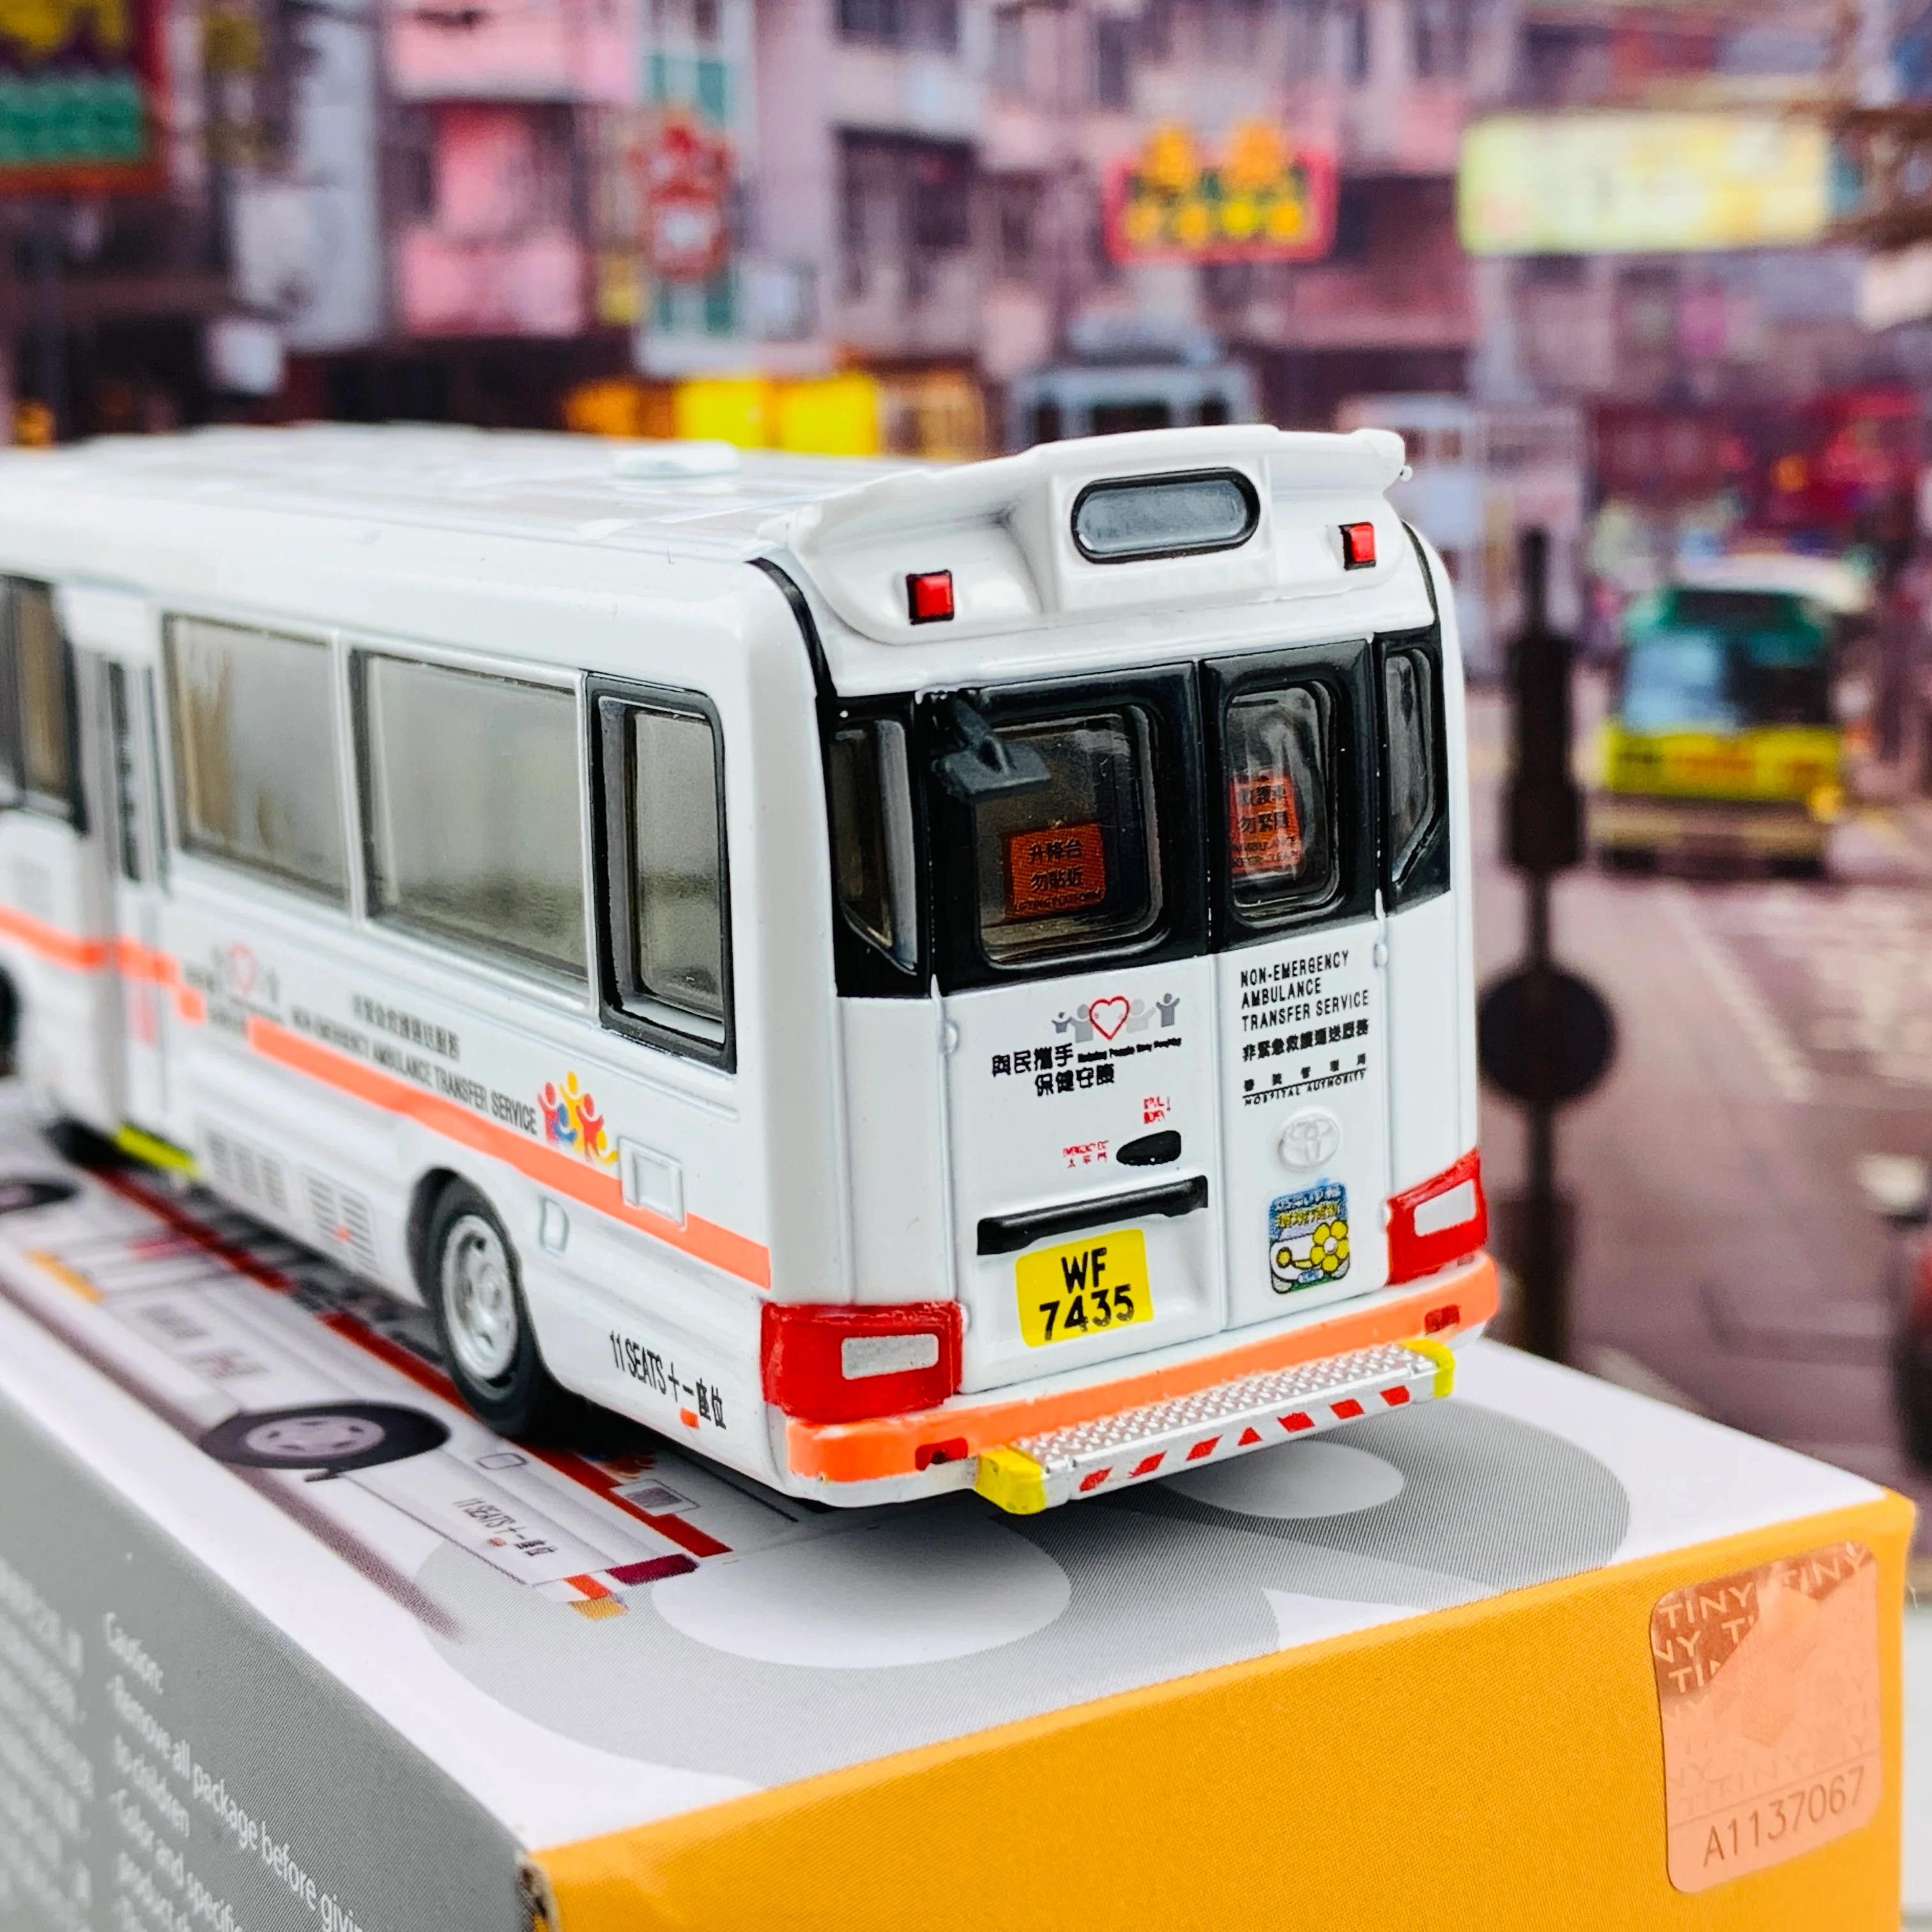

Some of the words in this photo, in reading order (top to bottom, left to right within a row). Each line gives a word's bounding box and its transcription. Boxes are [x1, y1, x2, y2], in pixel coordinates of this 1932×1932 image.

[1241, 949, 1349, 988] NON-EMERGENCY
[1241, 977, 1321, 1009] AMBULANCE
[1242, 1003, 1310, 1031] TRANSFER
[1315, 989, 1368, 1016] SERVICE
[434, 1064, 489, 1113] TRANSFER
[491, 1089, 538, 1136] SERVICE
[1061, 1247, 1107, 1294] WF
[1039, 1284, 1134, 1342] 7435
[610, 1330, 625, 1372] 11
[625, 1338, 666, 1395] SEATS
[1658, 1582, 1753, 1629] TINY
[172, 1739, 190, 1781] all
[194, 1761, 257, 1851] package
[262, 1821, 317, 1911] before
[320, 1893, 363, 1932] givi
[1703, 1764, 1864, 1868] A1137067
[156, 1837, 183, 1889] and
